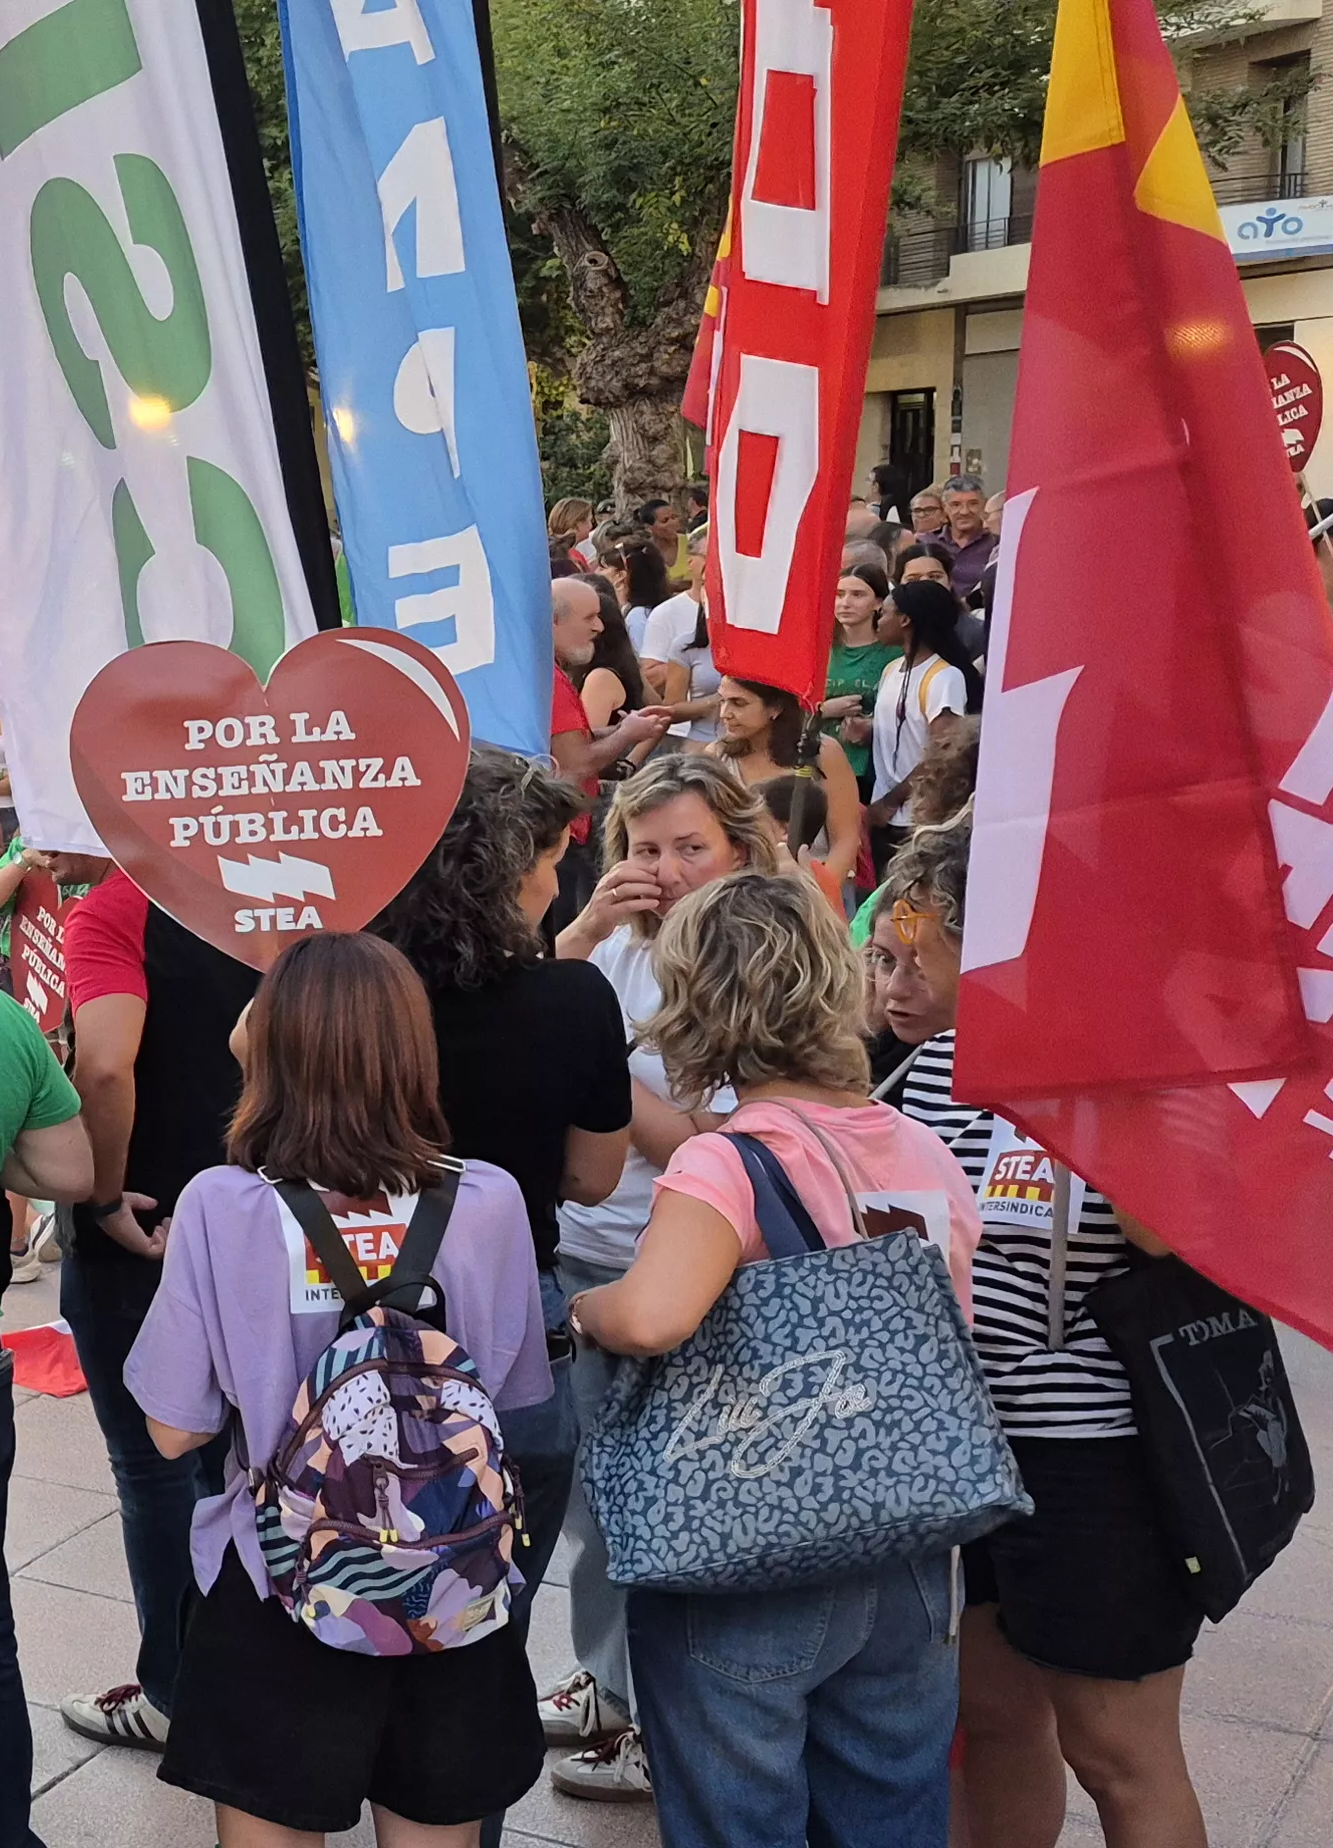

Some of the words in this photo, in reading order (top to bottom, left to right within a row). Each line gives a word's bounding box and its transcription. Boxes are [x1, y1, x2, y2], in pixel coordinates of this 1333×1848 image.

[1271, 383, 1313, 409] ANZA
[183, 714, 280, 750] POR
[289, 710, 356, 743] LA
[121, 753, 422, 802] ENSEÑANZA
[168, 805, 384, 848] PÚBLICA
[36, 905, 57, 938] POR
[234, 905, 324, 933] STEA
[19, 913, 67, 973] ENSEÑAN
[21, 943, 66, 999] PÚBLICA
[993, 1155, 1055, 1184] STEA
[341, 1231, 400, 1261] TEA
